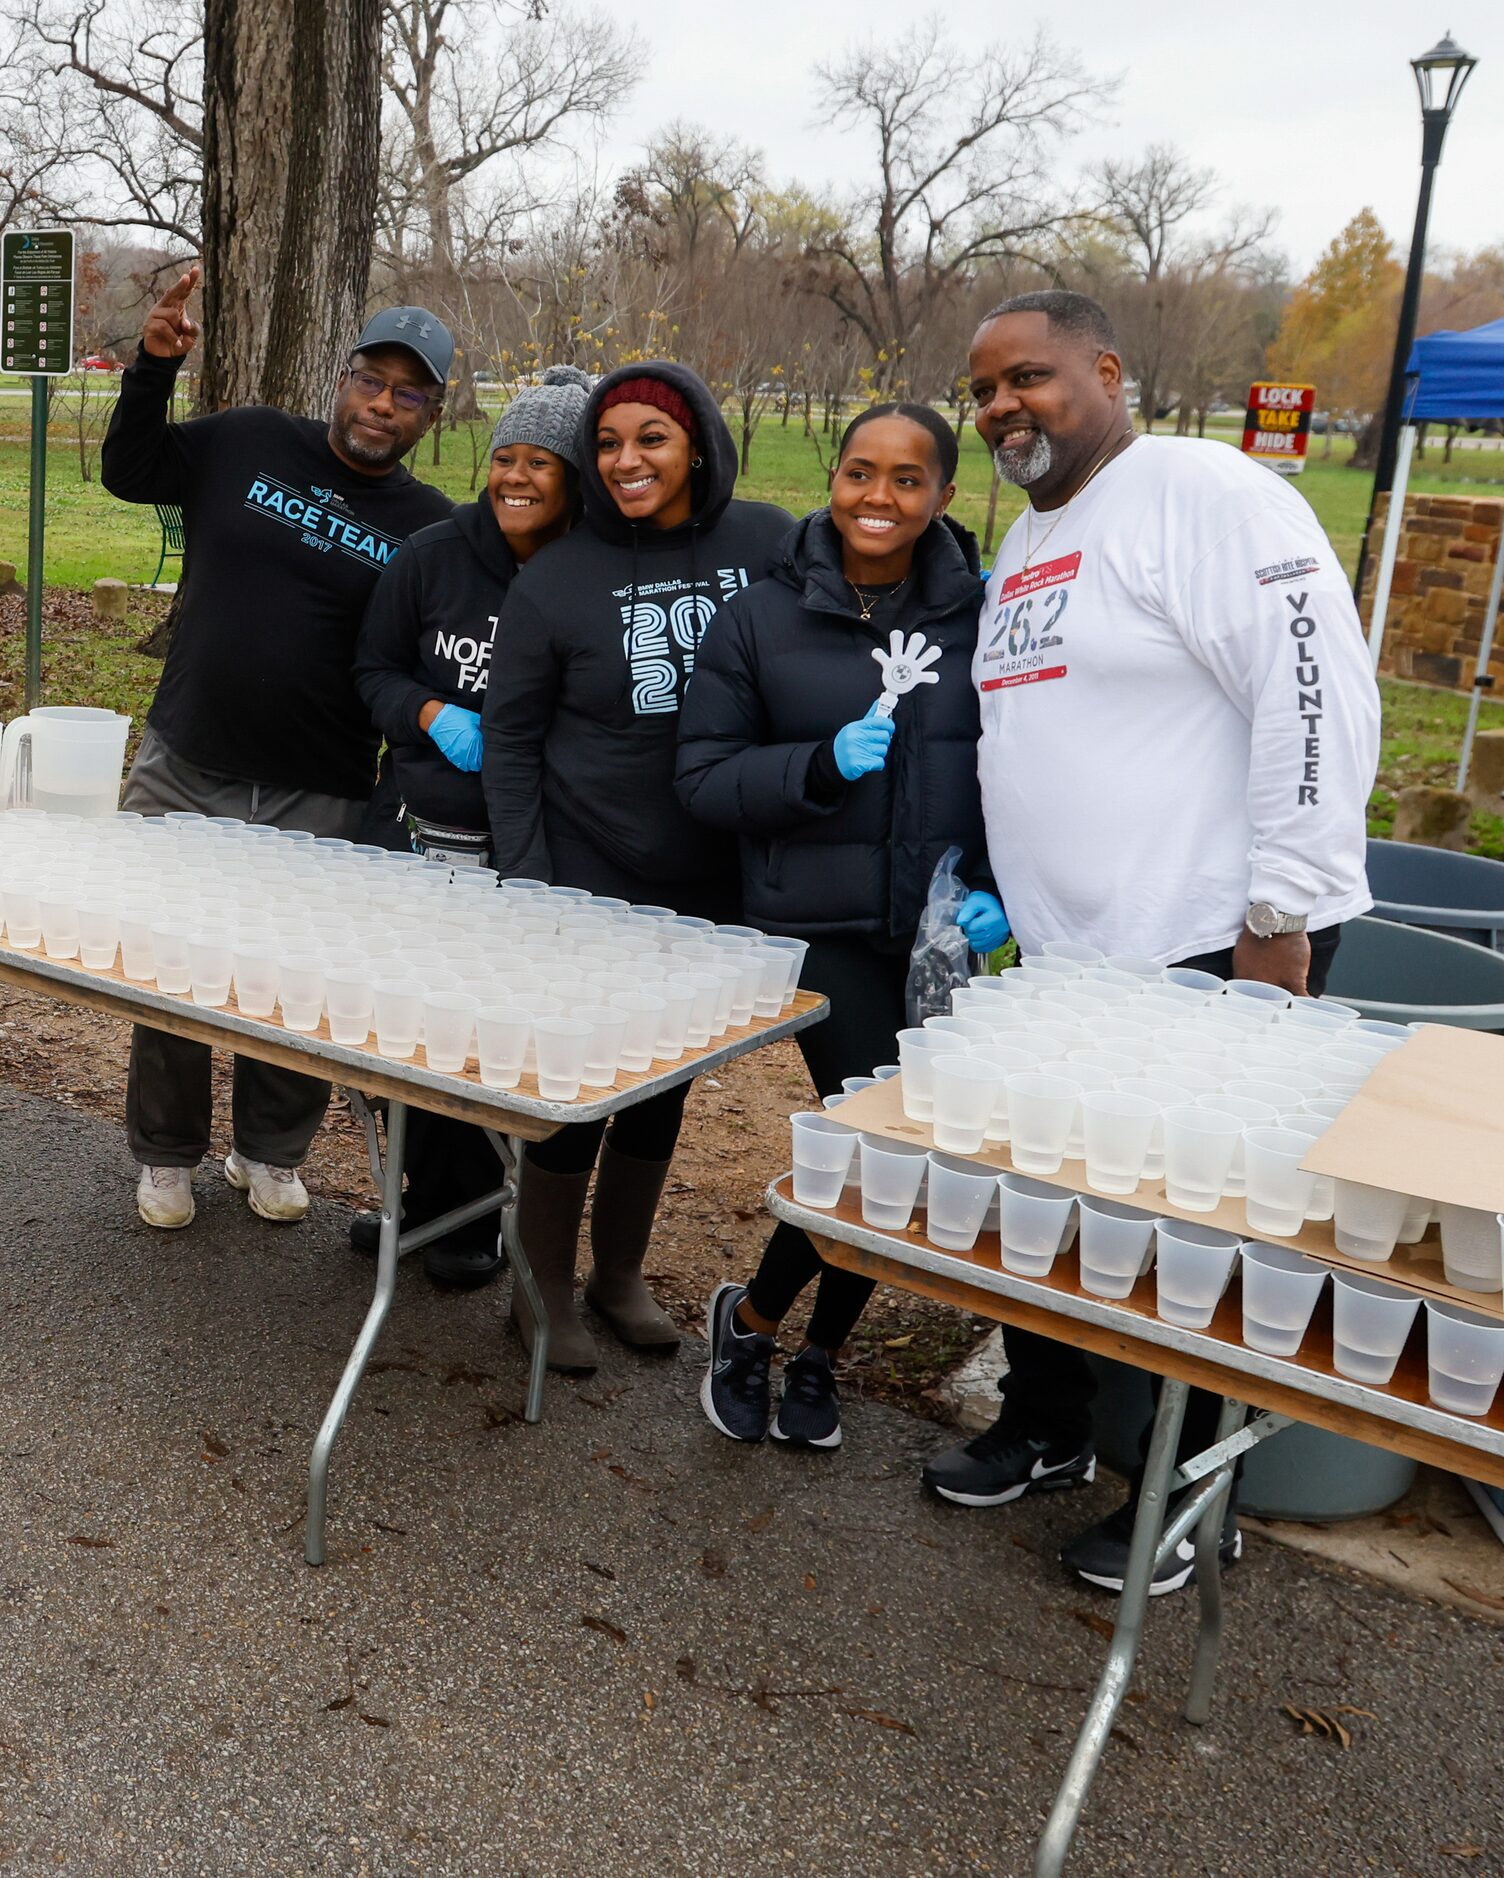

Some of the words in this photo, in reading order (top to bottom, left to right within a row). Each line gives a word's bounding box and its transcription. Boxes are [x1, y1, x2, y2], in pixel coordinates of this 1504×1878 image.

[1259, 388, 1304, 405] LOCK
[1258, 409, 1300, 427] TAKE
[1253, 432, 1295, 449] HIDE
[247, 480, 322, 530] RACE
[301, 533, 333, 553] 2017
[1282, 561, 1295, 572] RITE
[637, 582, 654, 592] BMW
[655, 579, 682, 588] DALLAS
[1029, 578, 1045, 590] Rock
[1044, 569, 1075, 585] Marathon
[638, 586, 677, 596] MARATHON
[983, 588, 1068, 662] 26.2
[999, 654, 1044, 674] MARATHON
[1001, 676, 1023, 686] December
[1286, 592, 1322, 806] VOLUNTEER
